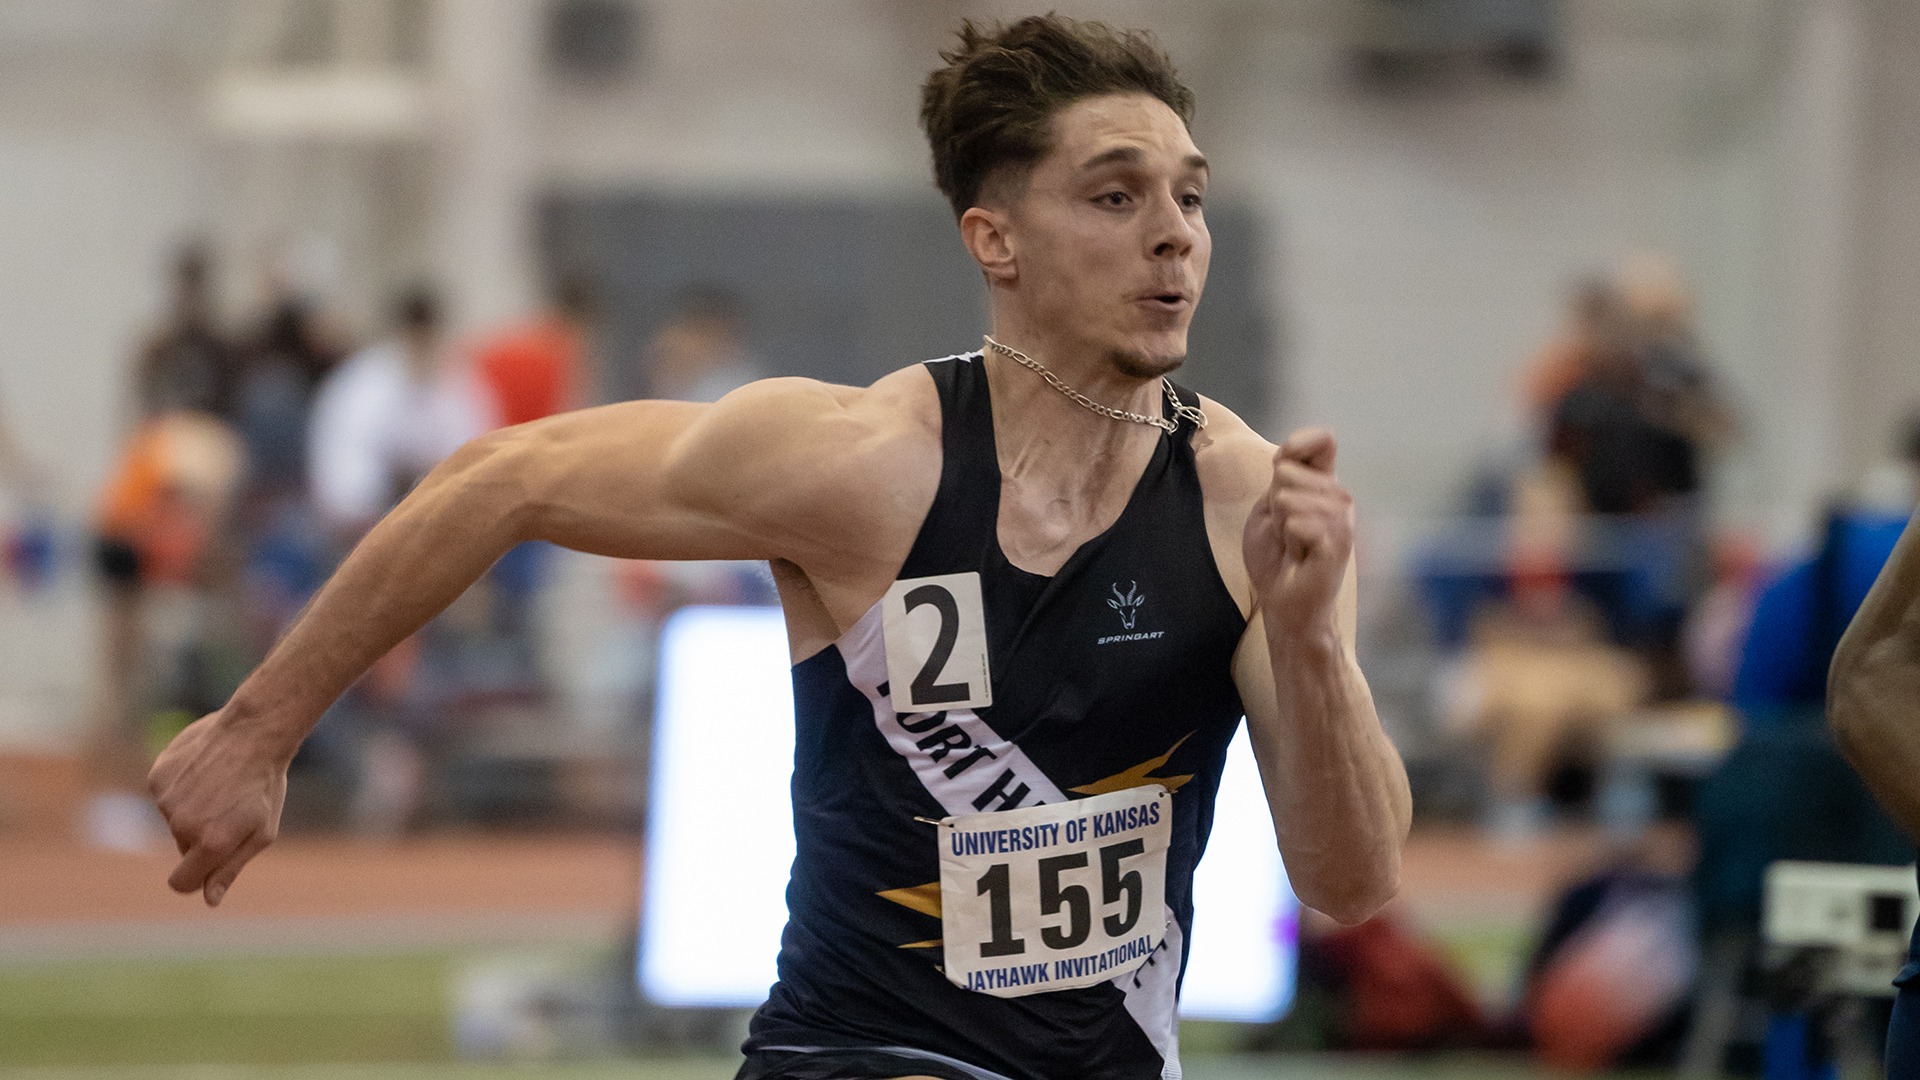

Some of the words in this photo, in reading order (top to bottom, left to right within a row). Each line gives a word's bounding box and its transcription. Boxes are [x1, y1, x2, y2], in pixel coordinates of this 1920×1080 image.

[903, 584, 971, 705] 2
[1097, 631, 1165, 645] SPRINGART
[877, 681, 997, 780] ORT
[951, 822, 1060, 856] UNIVERSITY
[1066, 818, 1087, 844] OF
[1093, 802, 1160, 838] KANSAS
[976, 838, 1145, 958] 155
[963, 962, 1049, 991] JAYHAWK
[1055, 934, 1154, 980] INVITATIONAL
